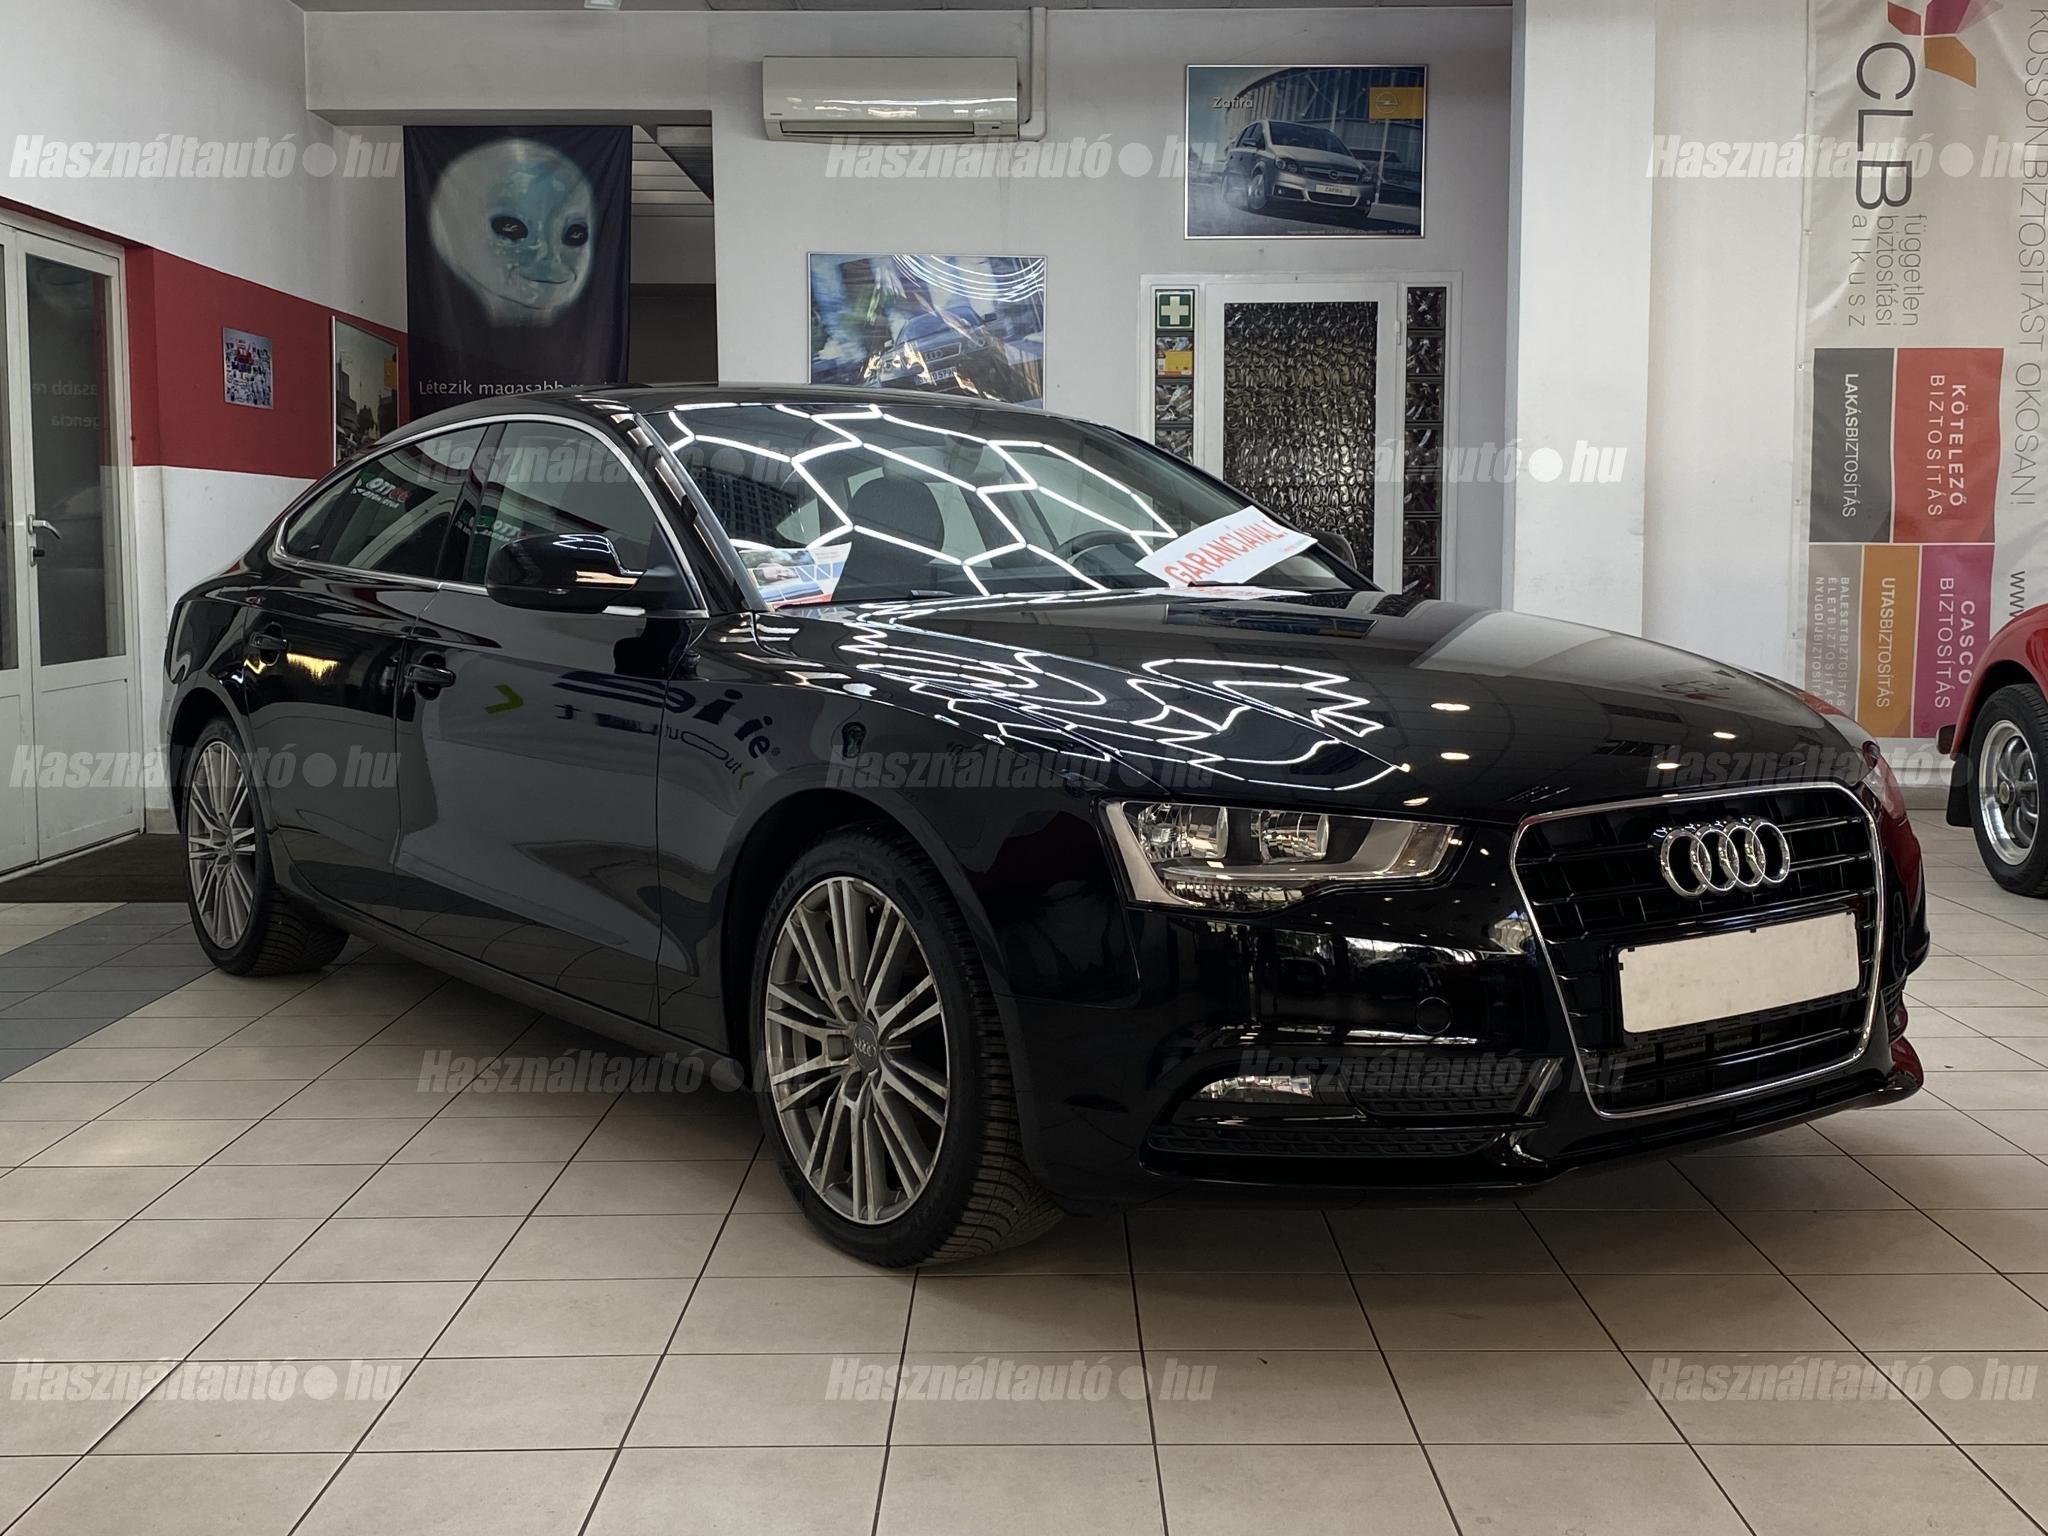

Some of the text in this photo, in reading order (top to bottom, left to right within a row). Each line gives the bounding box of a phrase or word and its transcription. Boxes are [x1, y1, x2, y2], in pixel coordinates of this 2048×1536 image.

[1211, 96, 1255, 109] Zafira
[1855, 41, 1916, 210] CLB
[1848, 214, 1872, 327] alkusz
[1875, 215, 1899, 326] biztosítási
[1899, 213, 1928, 327] független
[418, 380, 473, 395] Létezik
[1842, 373, 1862, 517] LAKÁSBIZTOSÍTÁS
[1926, 374, 1947, 516] BIZTOSÍTÁS
[1948, 384, 1969, 506] KÖTELEZŐ
[2010, 362, 2042, 505] OKOSAN!
[1836, 577, 1850, 706] BALESETBIZTOSÍTÁS
[1876, 577, 1896, 708] UTASBIZTOSÍTÁS
[1934, 577, 1956, 709] BIZTOSÍTÁS
[1958, 600, 1976, 685] CASCO
